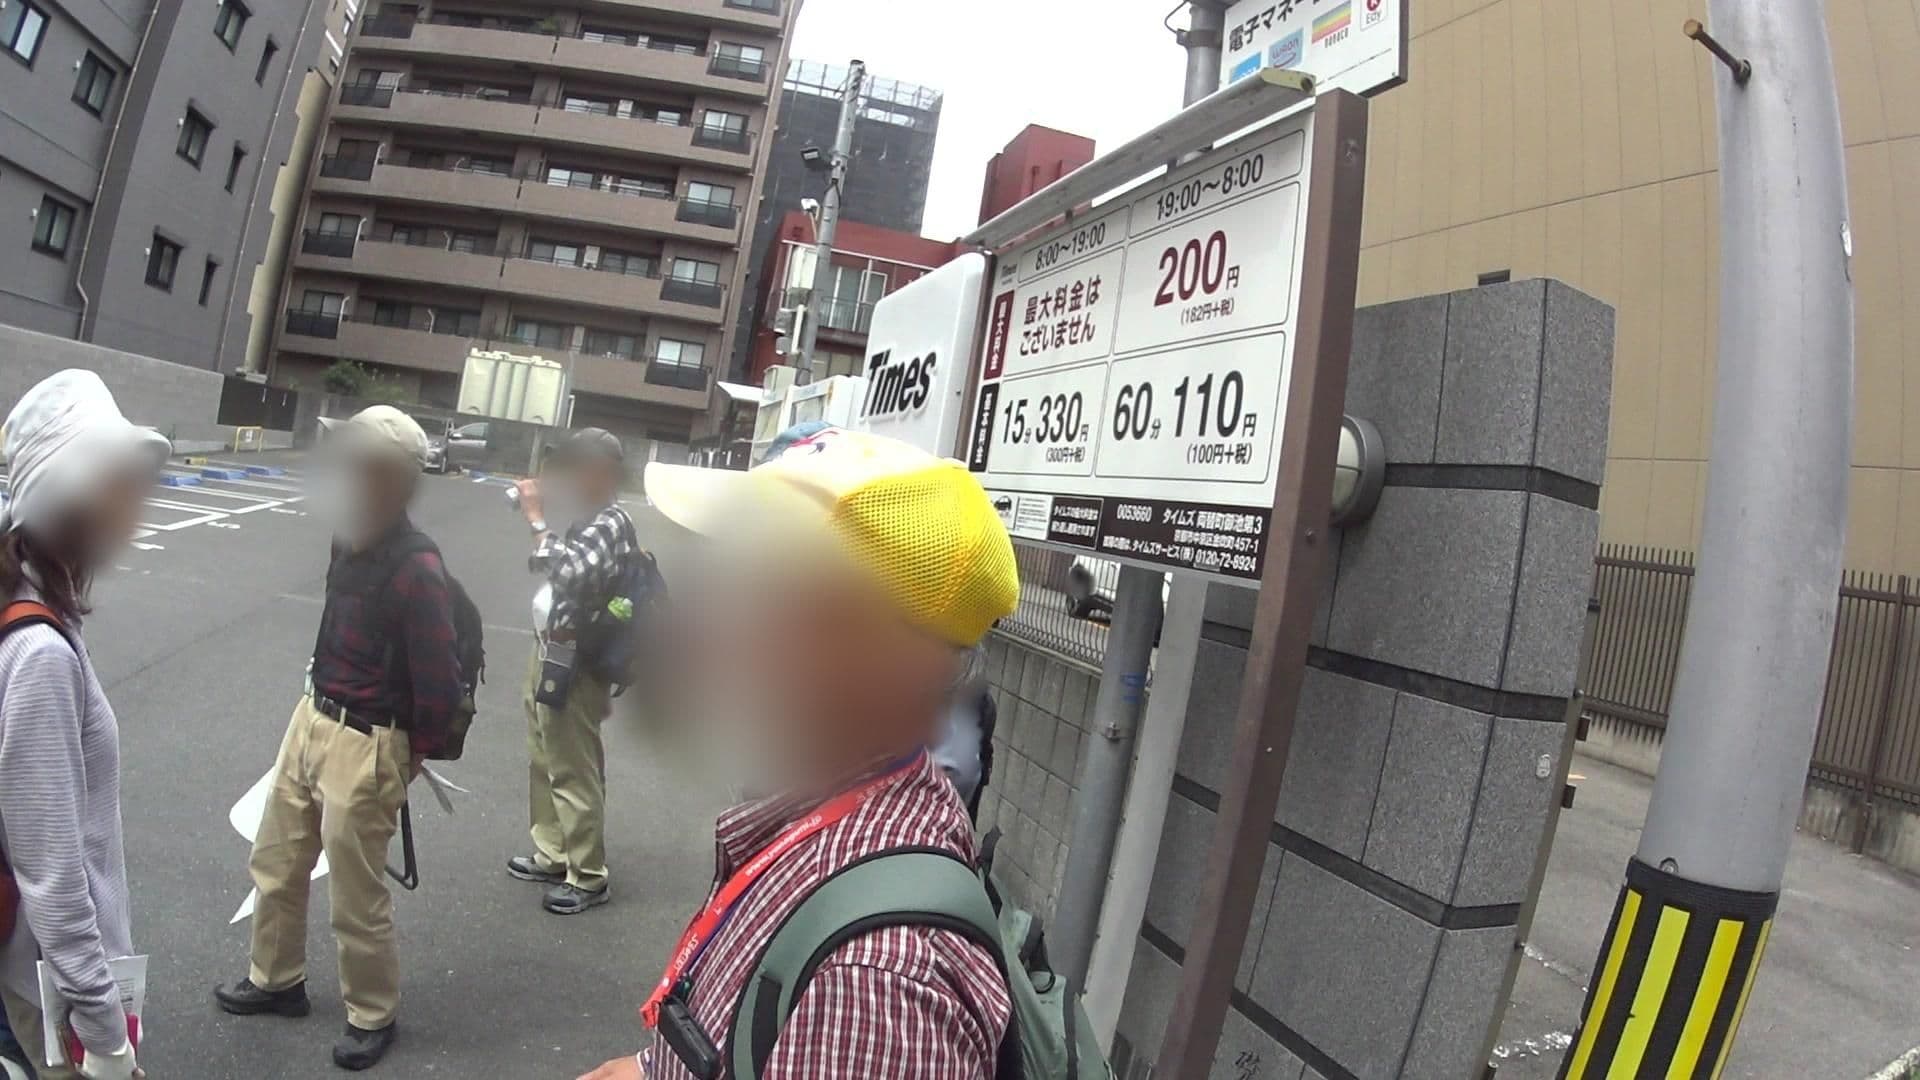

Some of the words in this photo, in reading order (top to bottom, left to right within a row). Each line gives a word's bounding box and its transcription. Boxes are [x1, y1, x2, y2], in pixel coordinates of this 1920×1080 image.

[1154, 230, 1240, 307] 200円
[1024, 275, 1101, 325] 最大料金は
[1020, 312, 1095, 356] ございません
[860, 349, 937, 418] Times
[1113, 382, 1161, 441] 60分
[1174, 370, 1257, 438] 110円
[1035, 391, 1089, 444] 330円
[1187, 443, 1252, 465] (100円+税)
[1162, 508, 1197, 527] タイムズ
